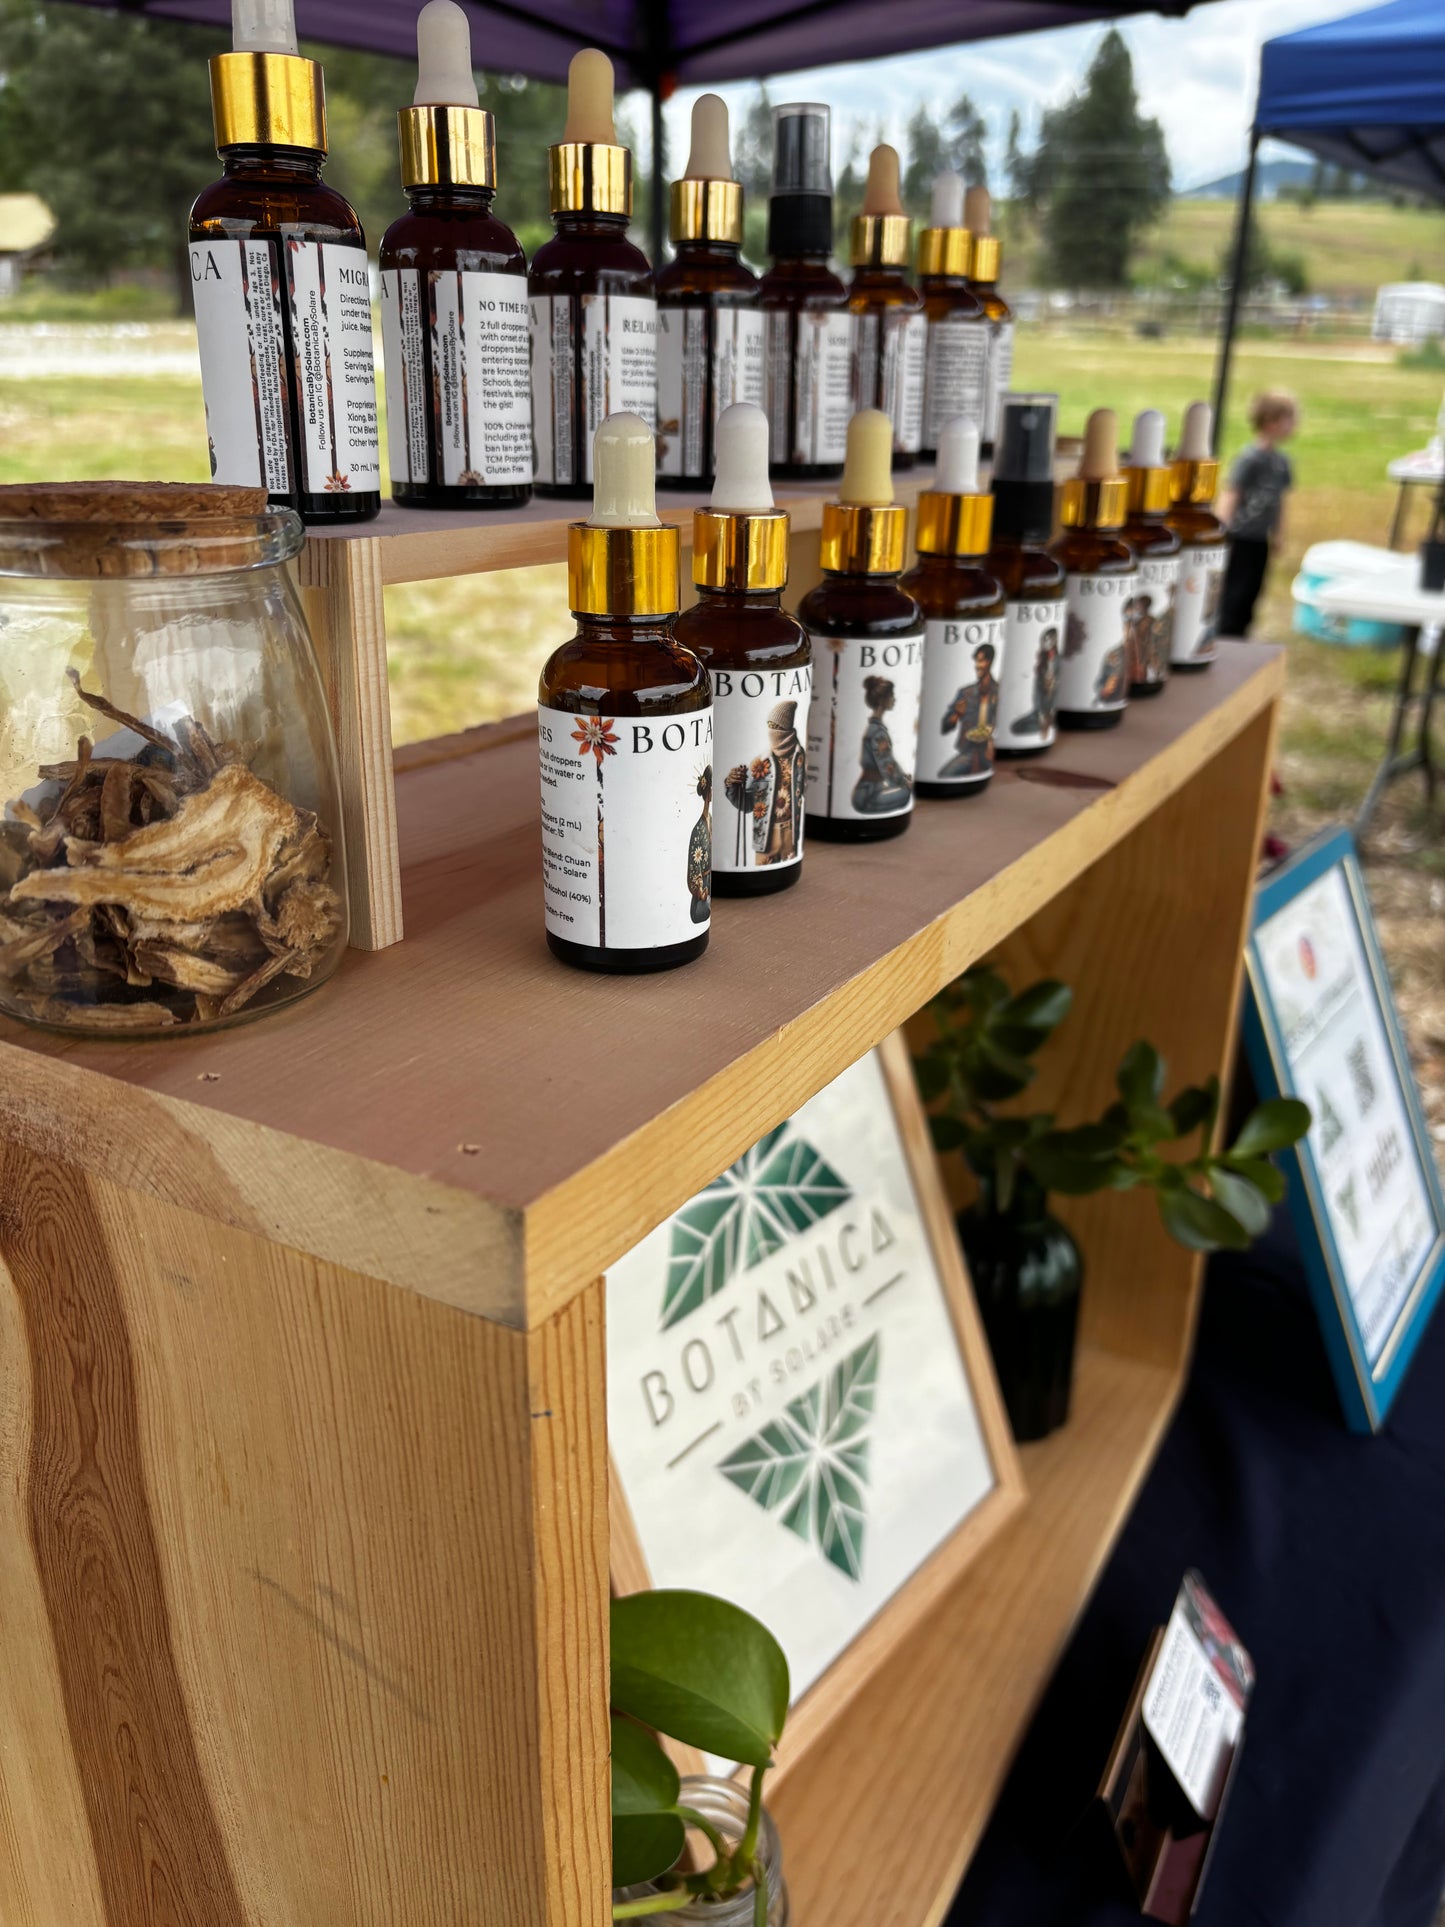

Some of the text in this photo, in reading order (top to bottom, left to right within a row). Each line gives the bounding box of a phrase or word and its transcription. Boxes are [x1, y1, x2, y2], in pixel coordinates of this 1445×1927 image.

[262, 253, 267, 262] Ca
[190, 250, 222, 281] CA
[257, 267, 265, 294] prevent
[479, 300, 496, 311] NO
[499, 302, 520, 313] TIME
[341, 309, 360, 318] under
[341, 320, 359, 331] juice.
[480, 320, 485, 330] 2
[487, 320, 500, 330] full
[269, 335, 275, 344] by
[480, 333, 499, 341] with
[448, 311, 459, 389] @BotanicaBySolare
[481, 344, 514, 354] droppers
[344, 361, 368, 372] Serving
[481, 356, 514, 366] entering
[270, 345, 279, 393] Manufactured
[303, 318, 316, 424] BotanicaBySolare.com
[309, 290, 326, 450] Follow us on IG @BotanicaBySolare
[496, 367, 520, 376] known
[258, 354, 267, 400] breastfeeding
[442, 335, 452, 426] BotanicaBySolare.com
[482, 379, 512, 388] Schools,
[451, 391, 458, 400] IG
[483, 390, 514, 398] festivals,
[452, 401, 458, 410] on
[483, 400, 513, 411] the gist!
[275, 395, 283, 436] supplement.
[453, 412, 459, 422] us
[348, 426, 363, 434] TCM
[484, 422, 504, 431] 100%
[349, 439, 368, 447] Other
[485, 444, 501, 452] ban
[272, 448, 279, 456] by
[277, 439, 285, 462] Dietary
[486, 455, 503, 463] TCM
[350, 463, 359, 471] 30
[486, 466, 511, 474] Gluten
[550, 754, 582, 768] droppers
[554, 768, 574, 780] water
[558, 817, 566, 827] (2
[567, 820, 582, 831] mL)
[548, 847, 591, 868] Blend: Chuan
[563, 866, 588, 879] Solare
[548, 882, 592, 904] Alcohol (40%)
[641, 1206, 897, 1428] BOTANICA
[731, 1377, 763, 1419] BY
